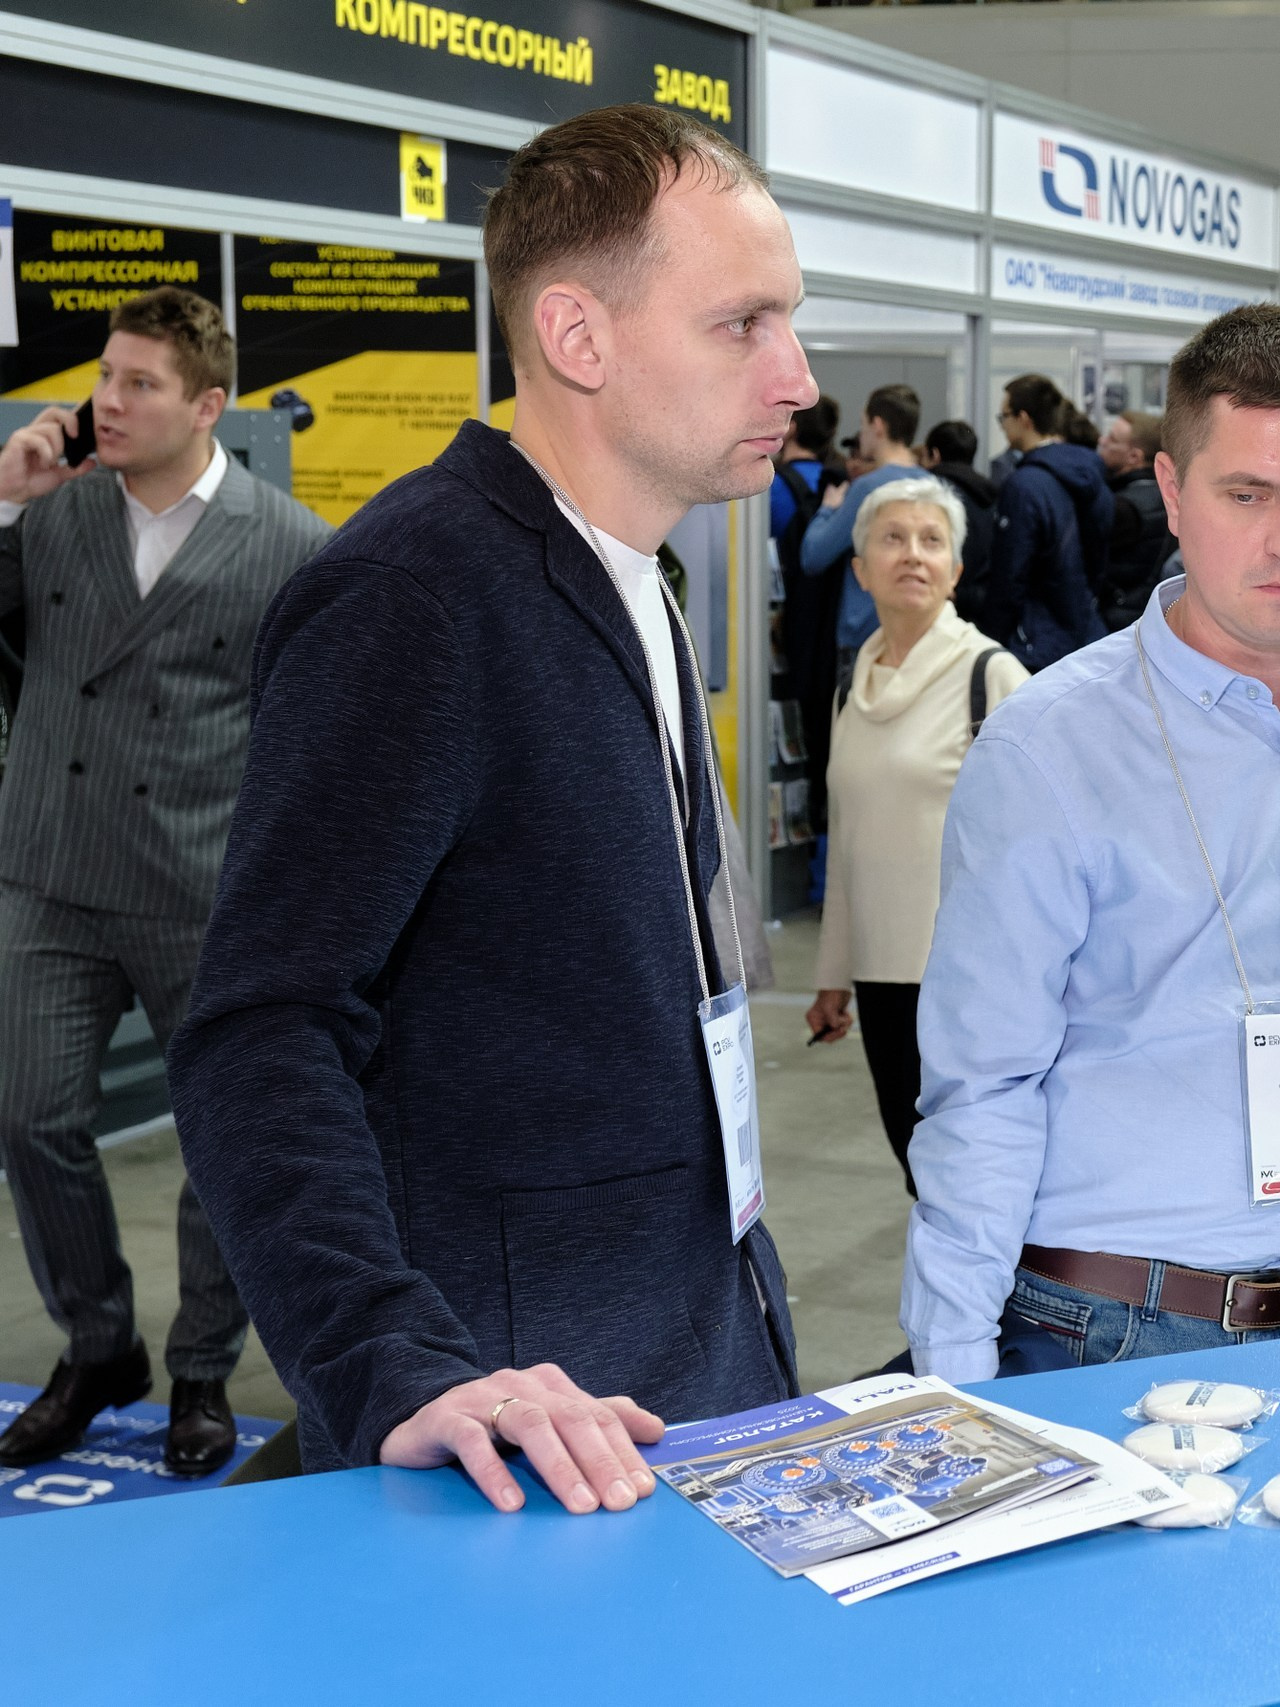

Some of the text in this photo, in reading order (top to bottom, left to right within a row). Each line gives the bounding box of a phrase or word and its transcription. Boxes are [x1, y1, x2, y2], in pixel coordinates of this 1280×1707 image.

[334, 0, 732, 123] КОМПРЕССОРНЫЙ ЗАВОД
[1108, 155, 1242, 250] NOVOGAS
[52, 229, 165, 252] ВИНТОВАЯ
[20, 260, 199, 283] КОМПРЕССОРНАЯ
[851, 1384, 917, 1403] DALI
[713, 1410, 824, 1445] КАТАЛОГ
